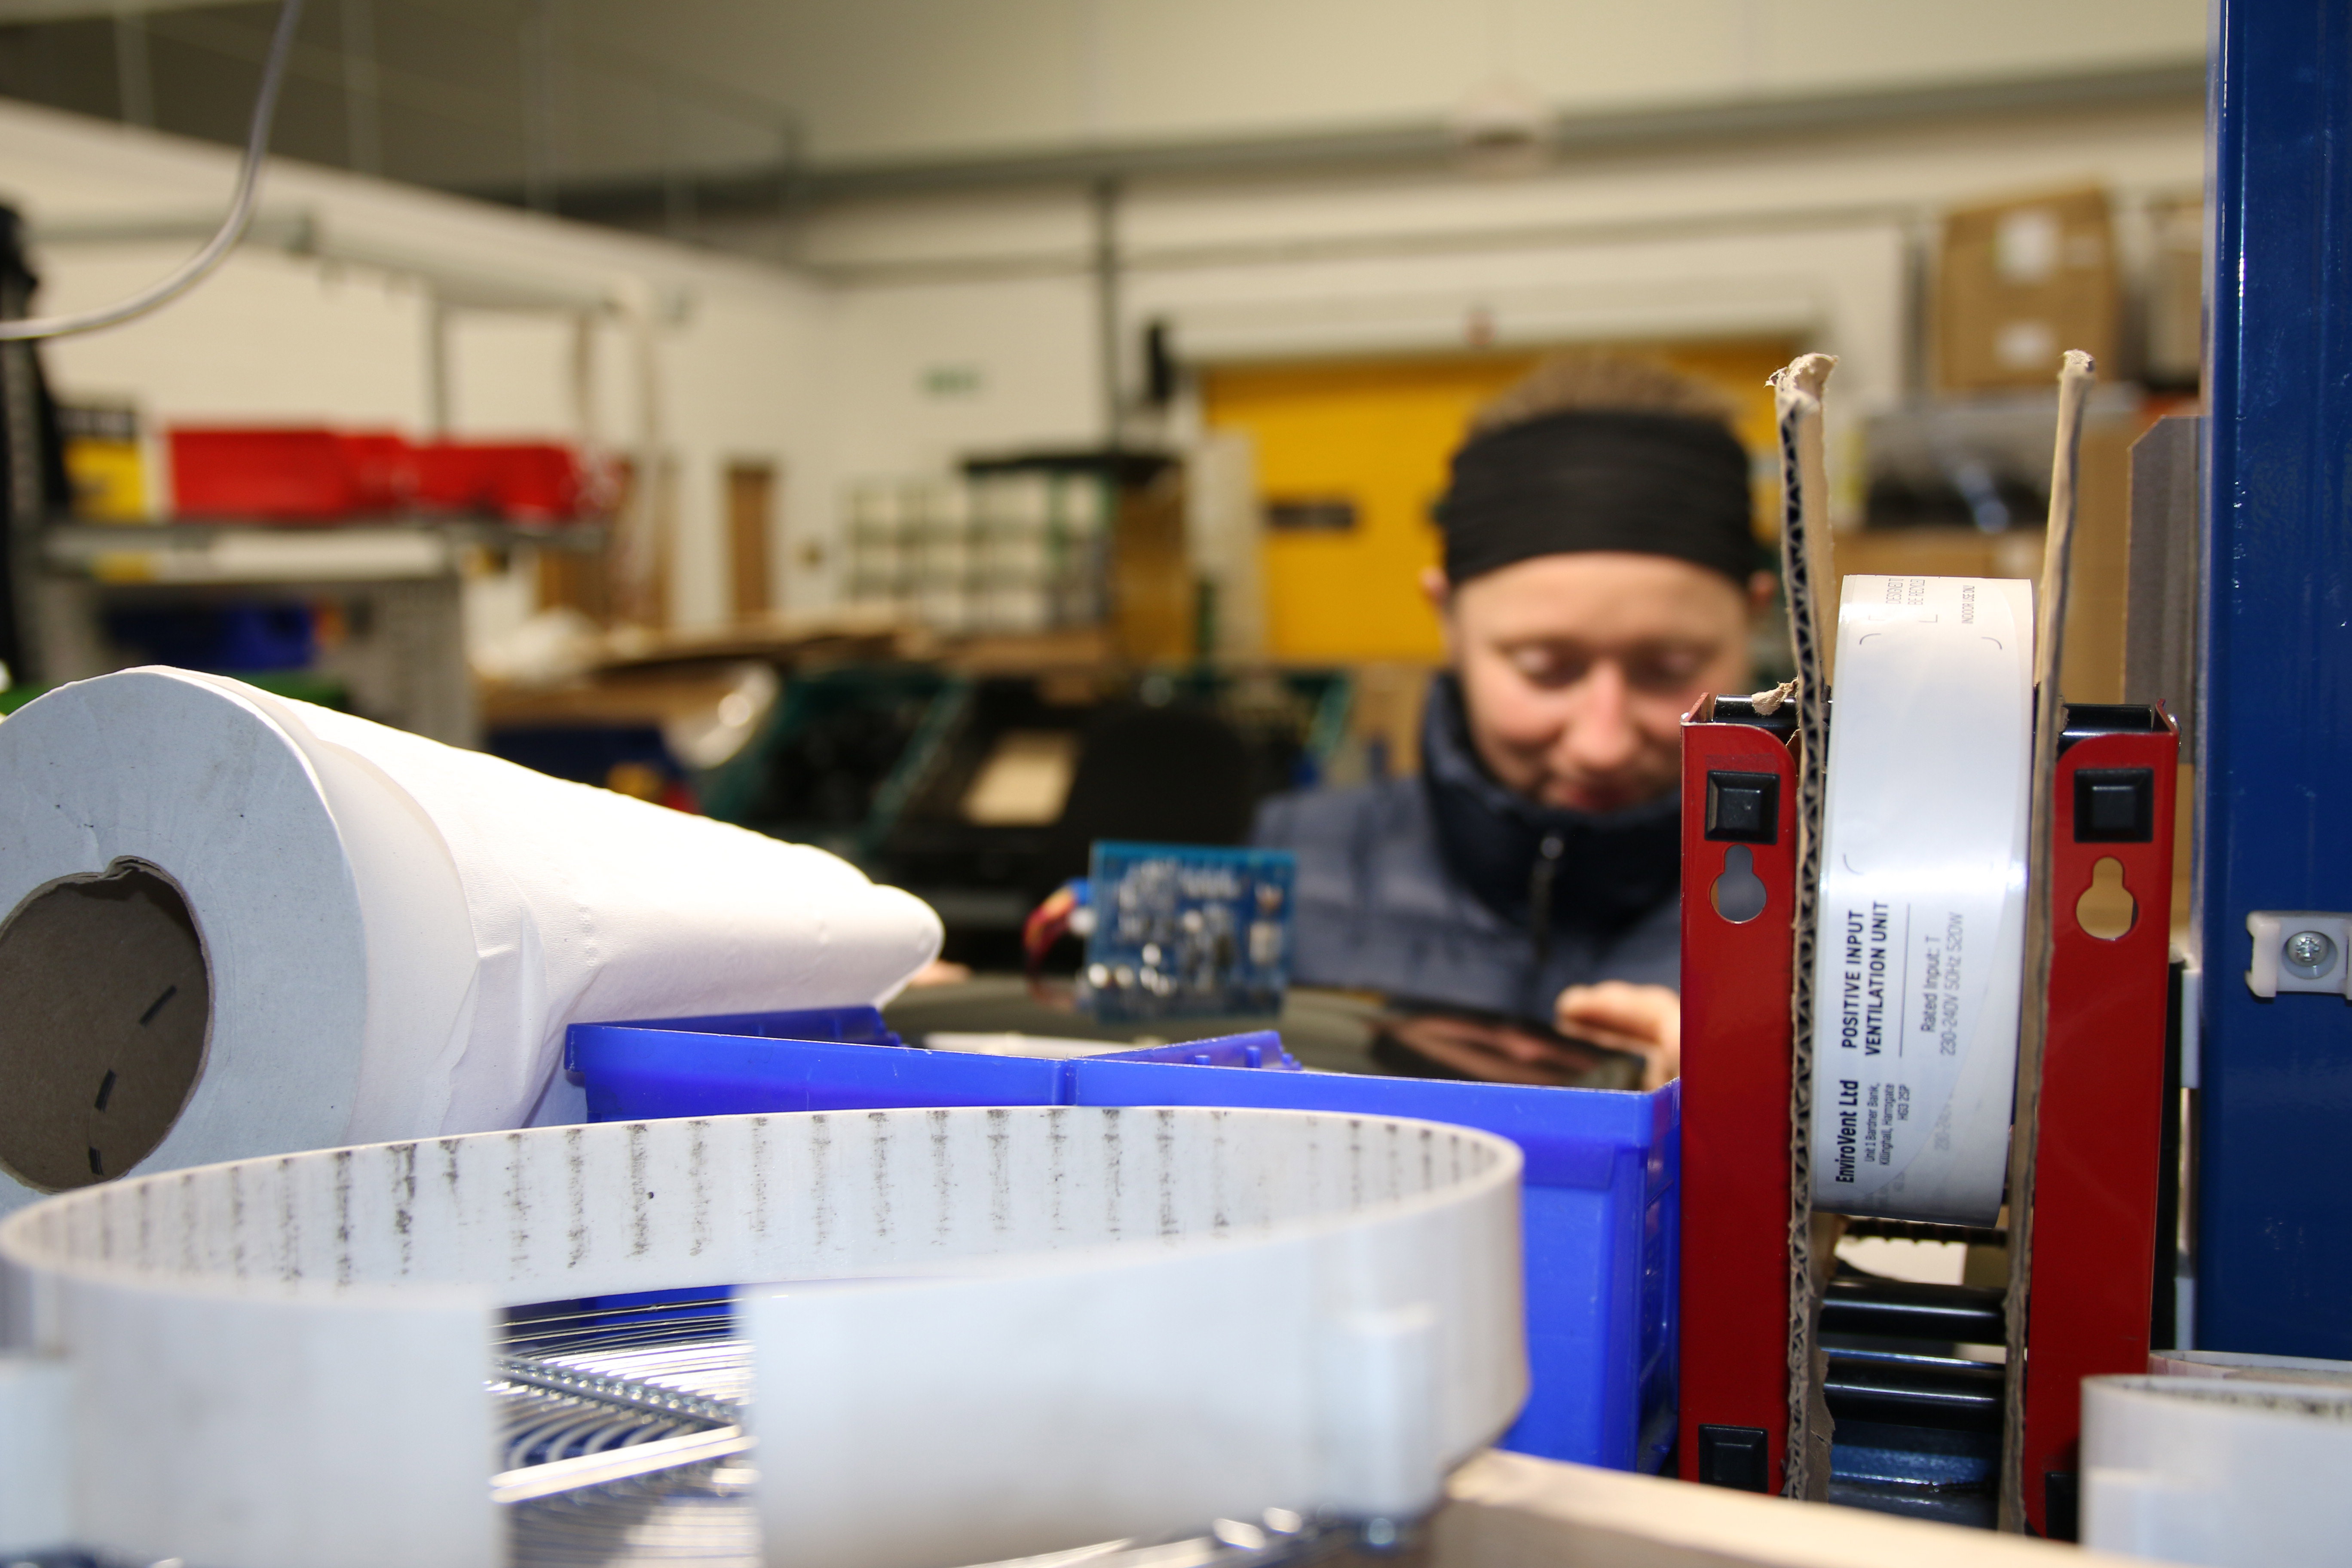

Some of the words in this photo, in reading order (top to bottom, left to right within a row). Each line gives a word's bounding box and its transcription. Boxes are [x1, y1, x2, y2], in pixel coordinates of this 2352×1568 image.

[1962, 603, 1974, 624] INDOOR
[1963, 594, 1975, 602] USE
[1846, 910, 1864, 964] INPUT
[1871, 900, 1888, 942] UNIT
[1925, 934, 1940, 944] T
[1947, 912, 1963, 951] 520W
[1924, 947, 1940, 989] Input:
[1944, 956, 1961, 990] 50Hz
[1842, 972, 1860, 1049] POSITIVE
[1865, 948, 1885, 1056] VENTILATION
[1921, 993, 1937, 1032] Rated
[1939, 993, 1958, 1056] 230-240V
[1839, 1080, 1859, 1107] Ltd
[1835, 1111, 1857, 1183] EnviroVent
[1865, 1148, 1875, 1162] Unit
